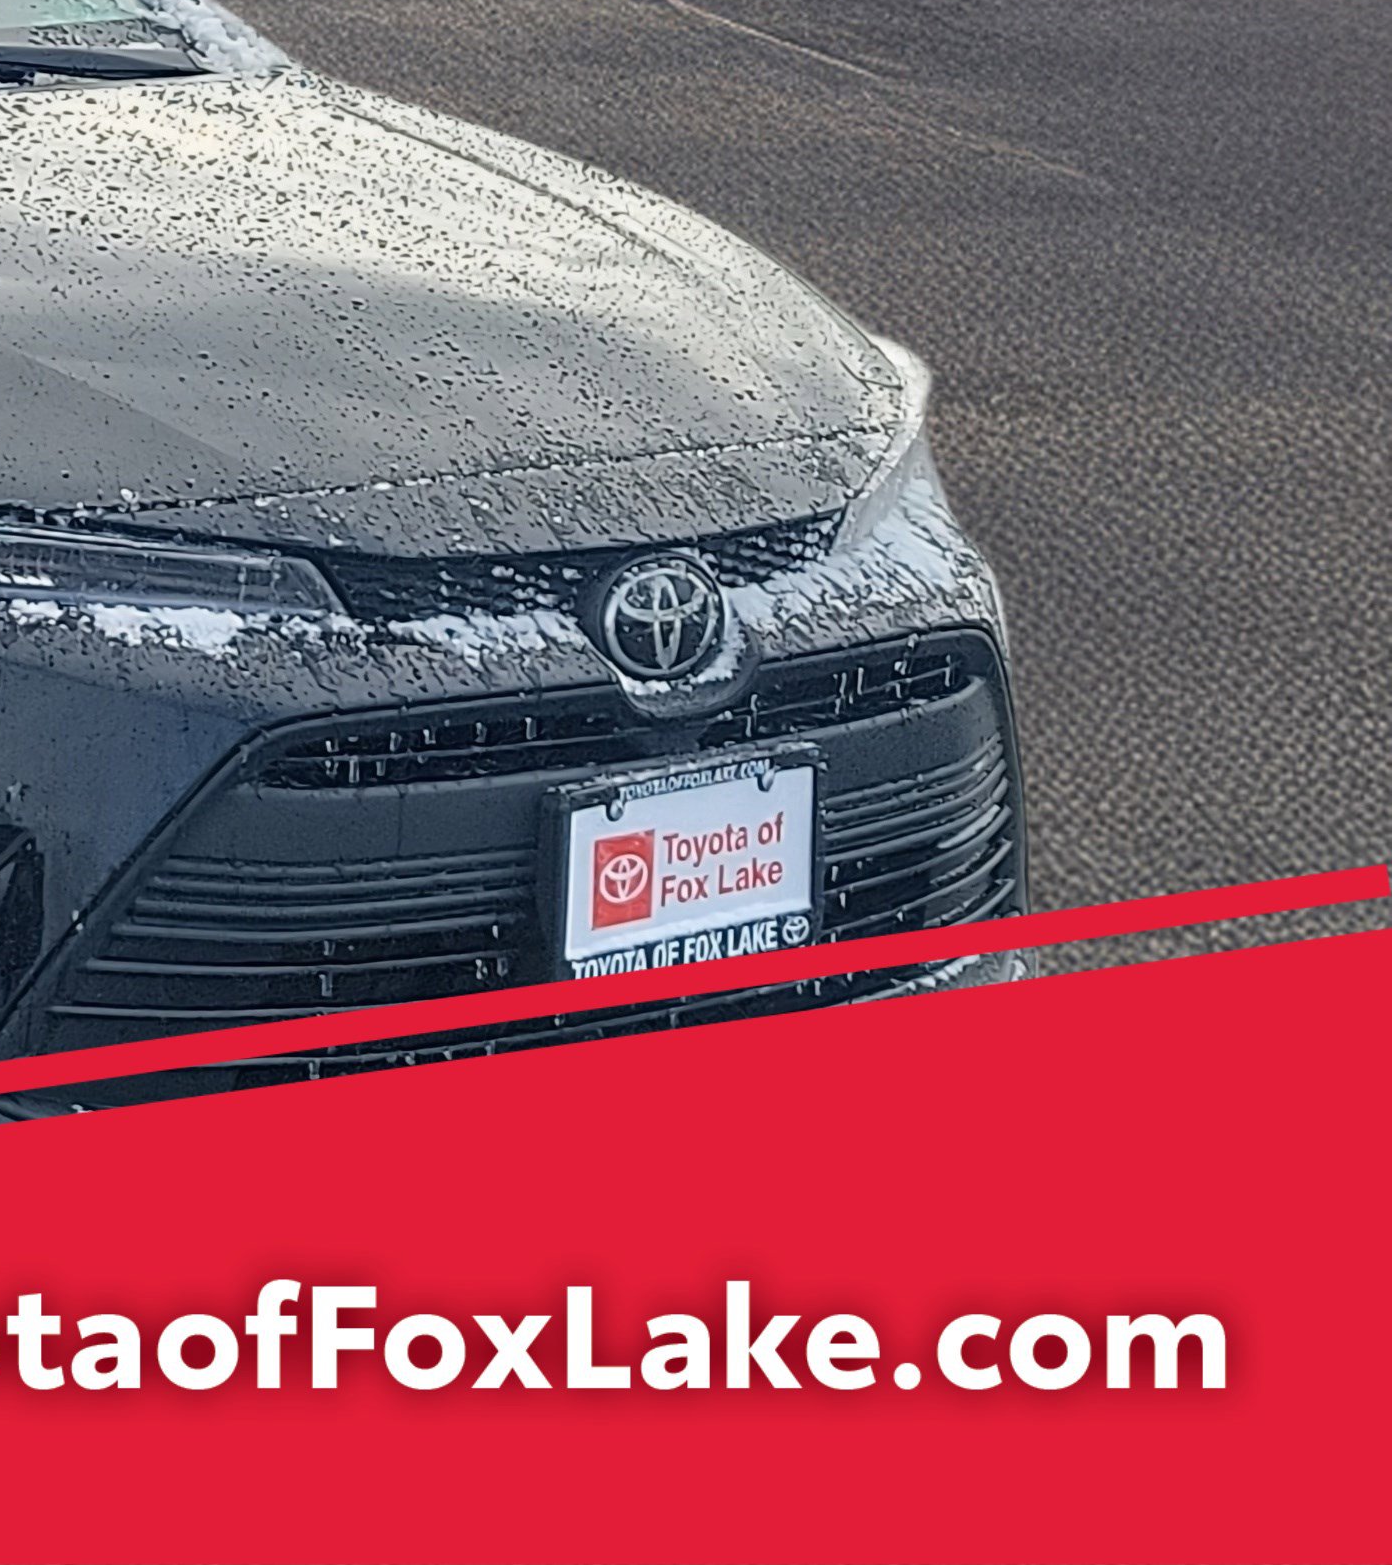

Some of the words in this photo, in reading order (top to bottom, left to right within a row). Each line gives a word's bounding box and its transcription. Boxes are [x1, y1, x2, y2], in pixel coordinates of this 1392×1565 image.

[662, 823, 748, 868] Toyota
[758, 811, 784, 845] of
[660, 874, 709, 907] Fox
[718, 857, 783, 895] Lake
[571, 947, 647, 980] TOYOTA
[651, 939, 680, 968] OF
[683, 930, 723, 963] FOX
[727, 920, 778, 958] LAKE
